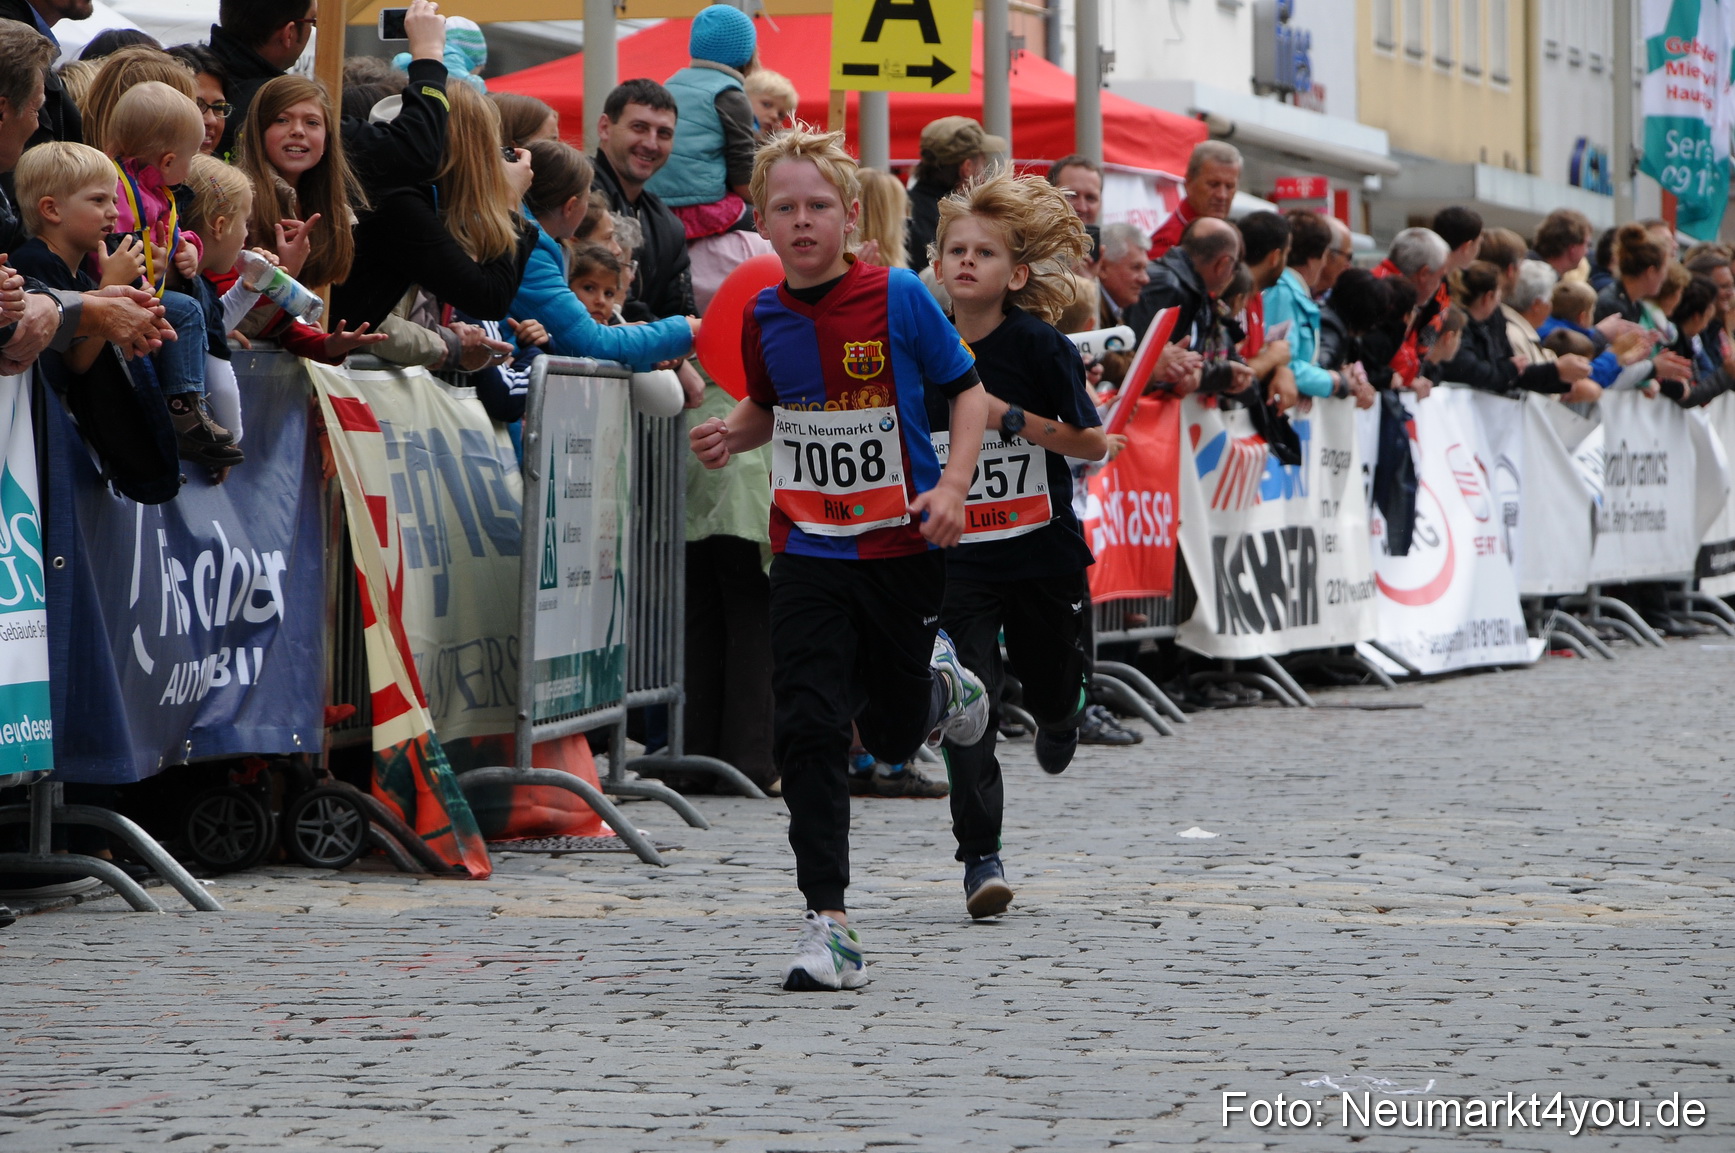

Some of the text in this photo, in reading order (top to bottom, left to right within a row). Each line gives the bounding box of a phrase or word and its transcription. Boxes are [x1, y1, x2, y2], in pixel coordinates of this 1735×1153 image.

[861, 0, 942, 44] A
[808, 423, 873, 436] Neumarkt
[783, 439, 886, 487] 7068
[941, 454, 1031, 501] 257
[824, 499, 851, 520] Rik
[969, 508, 1007, 528] Luis
[0, 619, 38, 642] Gebäude
